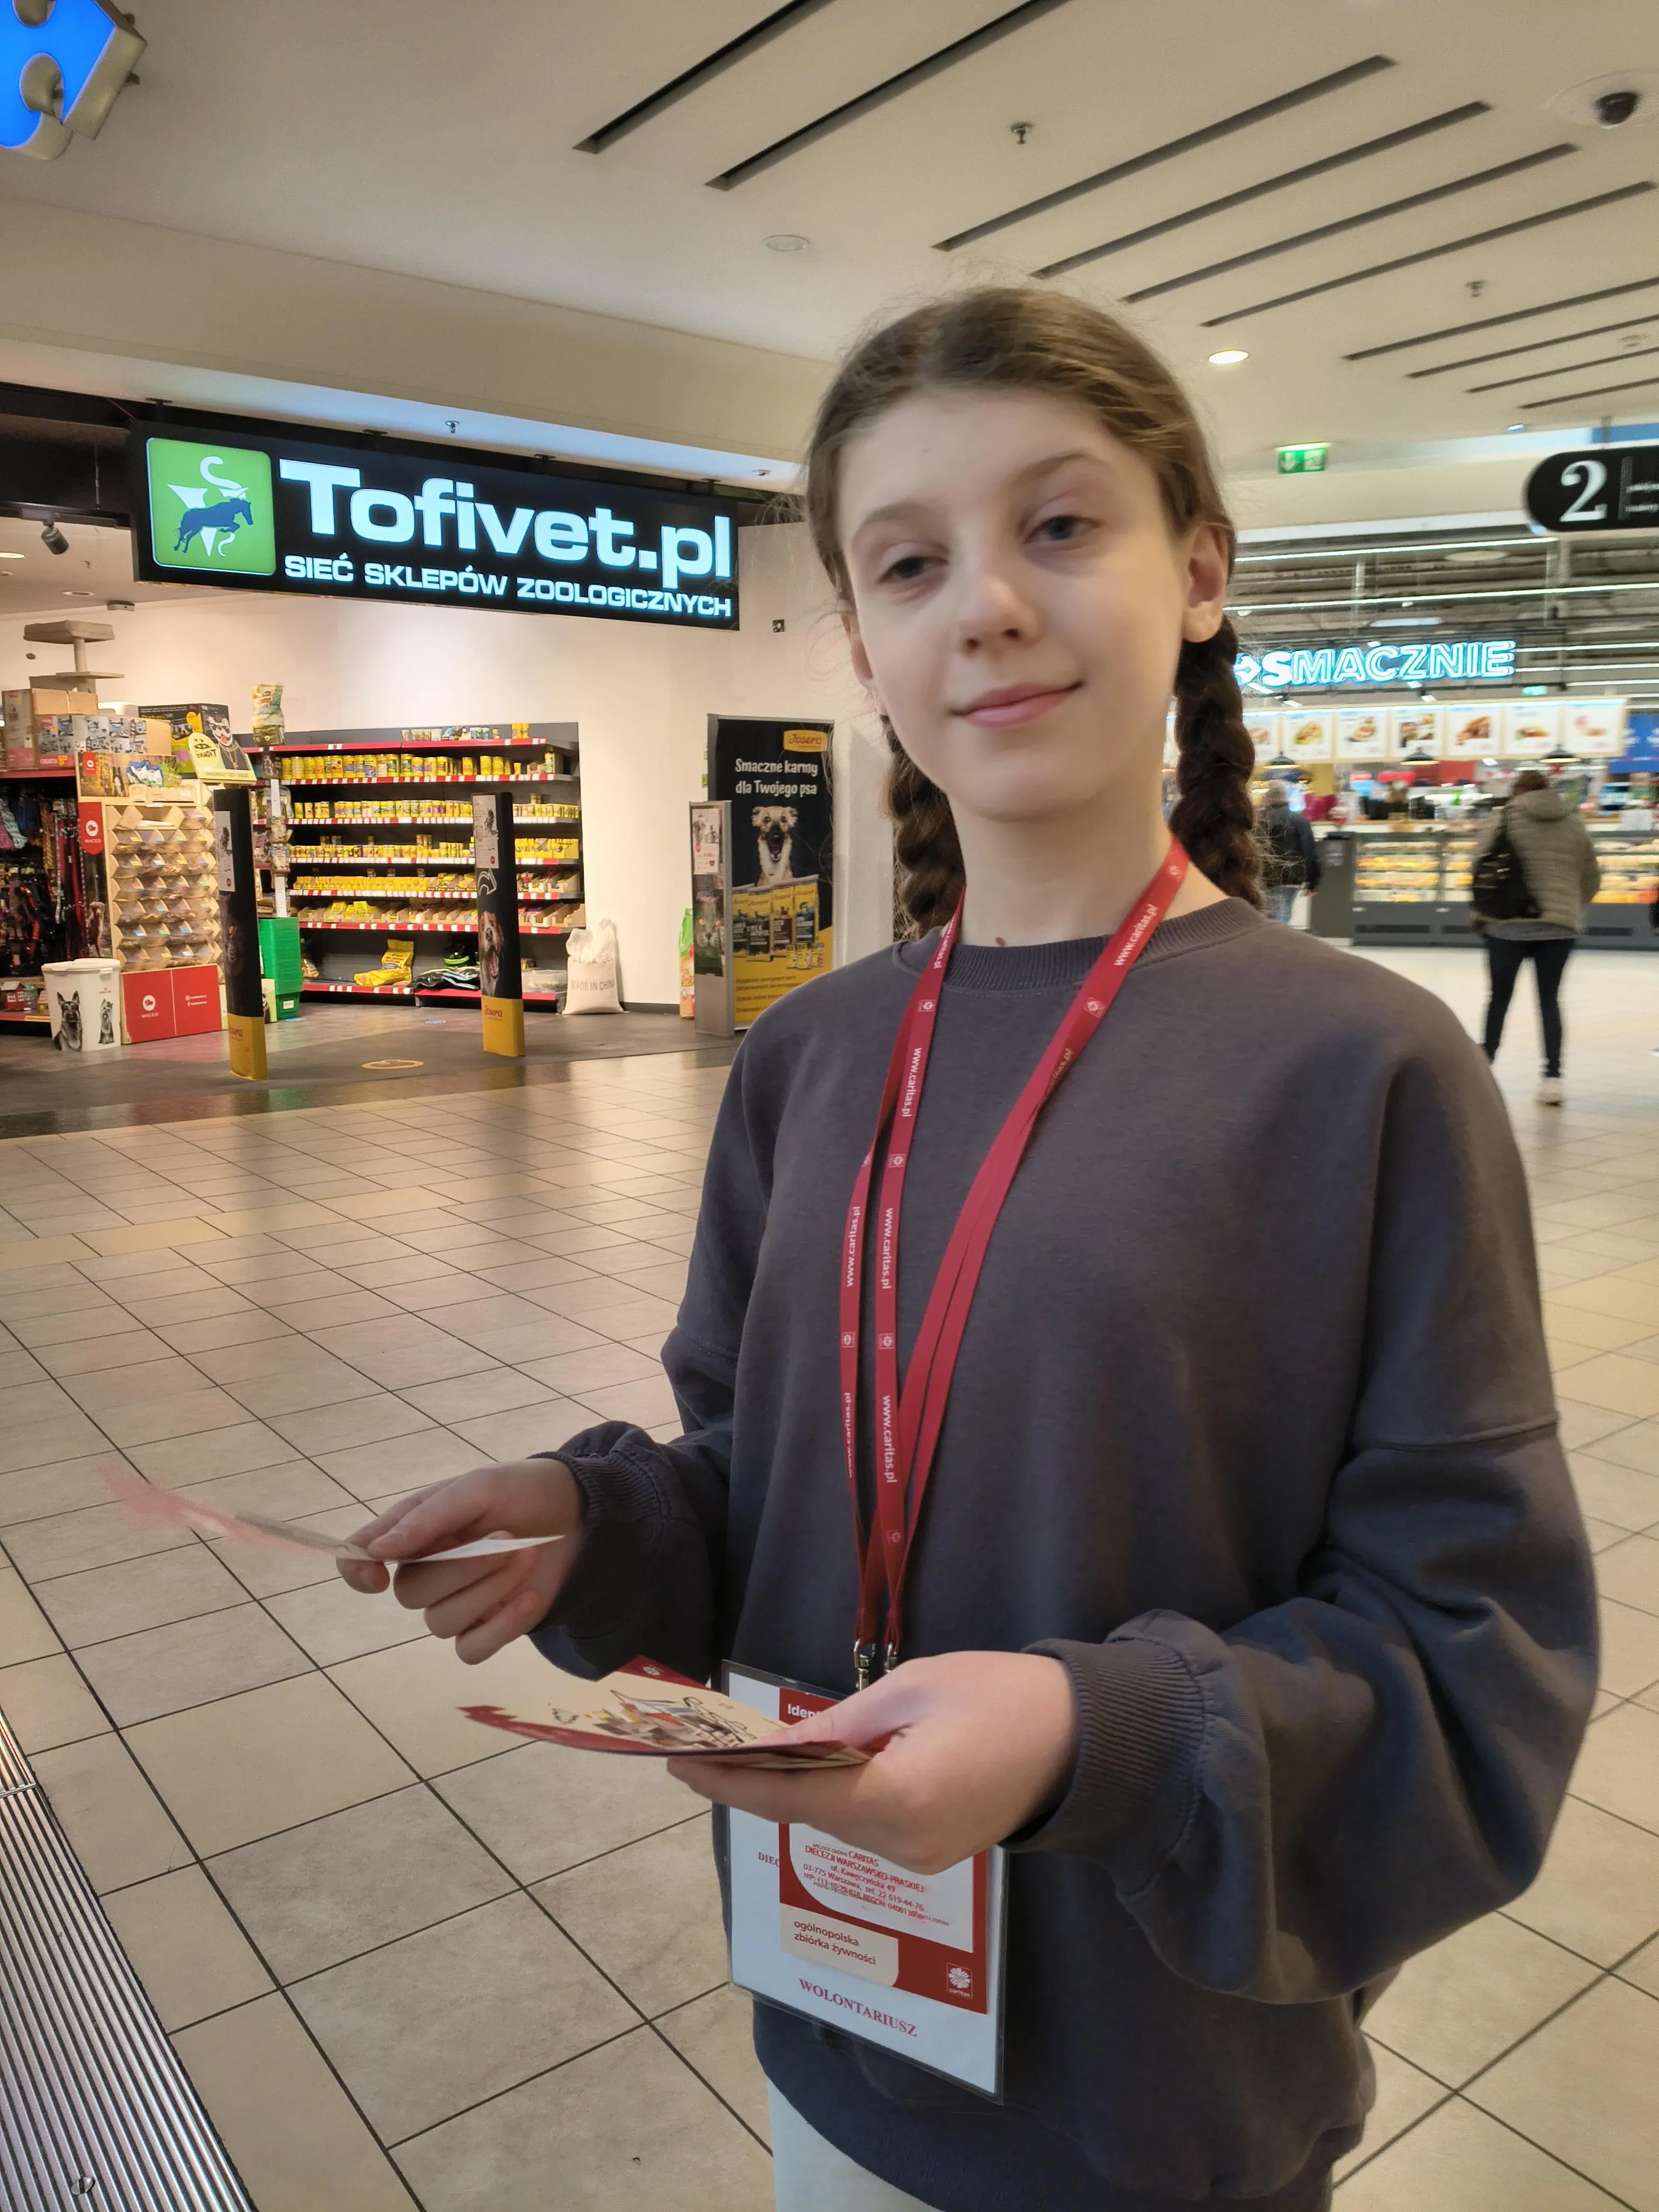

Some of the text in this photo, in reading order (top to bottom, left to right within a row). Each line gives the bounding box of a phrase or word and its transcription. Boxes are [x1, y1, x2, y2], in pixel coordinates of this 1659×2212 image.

[1560, 460, 1608, 522] 2
[279, 458, 732, 589] Tofivet.pl
[285, 552, 732, 618] SIEĆ SKLEPÓW ZOOLOGICZNYCH
[1262, 640, 1515, 686] SMACZNIE
[735, 758, 818, 777] Smaczne karmy
[736, 780, 818, 798] dla Twojego psa
[1114, 903, 1159, 966] www.caritas.pl
[571, 979, 615, 991] MADE IN CHINA
[901, 1047, 923, 1117] www.caritas.pl
[846, 1205, 861, 1287] www.caritas.pl
[881, 1208, 893, 1290] www.caritas.pl
[882, 1395, 898, 1483] www.caritas.pl
[787, 1703, 820, 1718] Iden
[805, 1845, 835, 1862] DIECEZJI
[848, 1851, 879, 1867] CARITAS
[804, 1863, 827, 1877] 03-775
[866, 1886, 875, 1895] tel.
[878, 1890, 886, 1898] 22
[794, 1921, 859, 1946] ogólnopolska
[794, 1932, 876, 1965] zbiórka żywności
[799, 1978, 918, 2037] WOLONTARIUSZ
